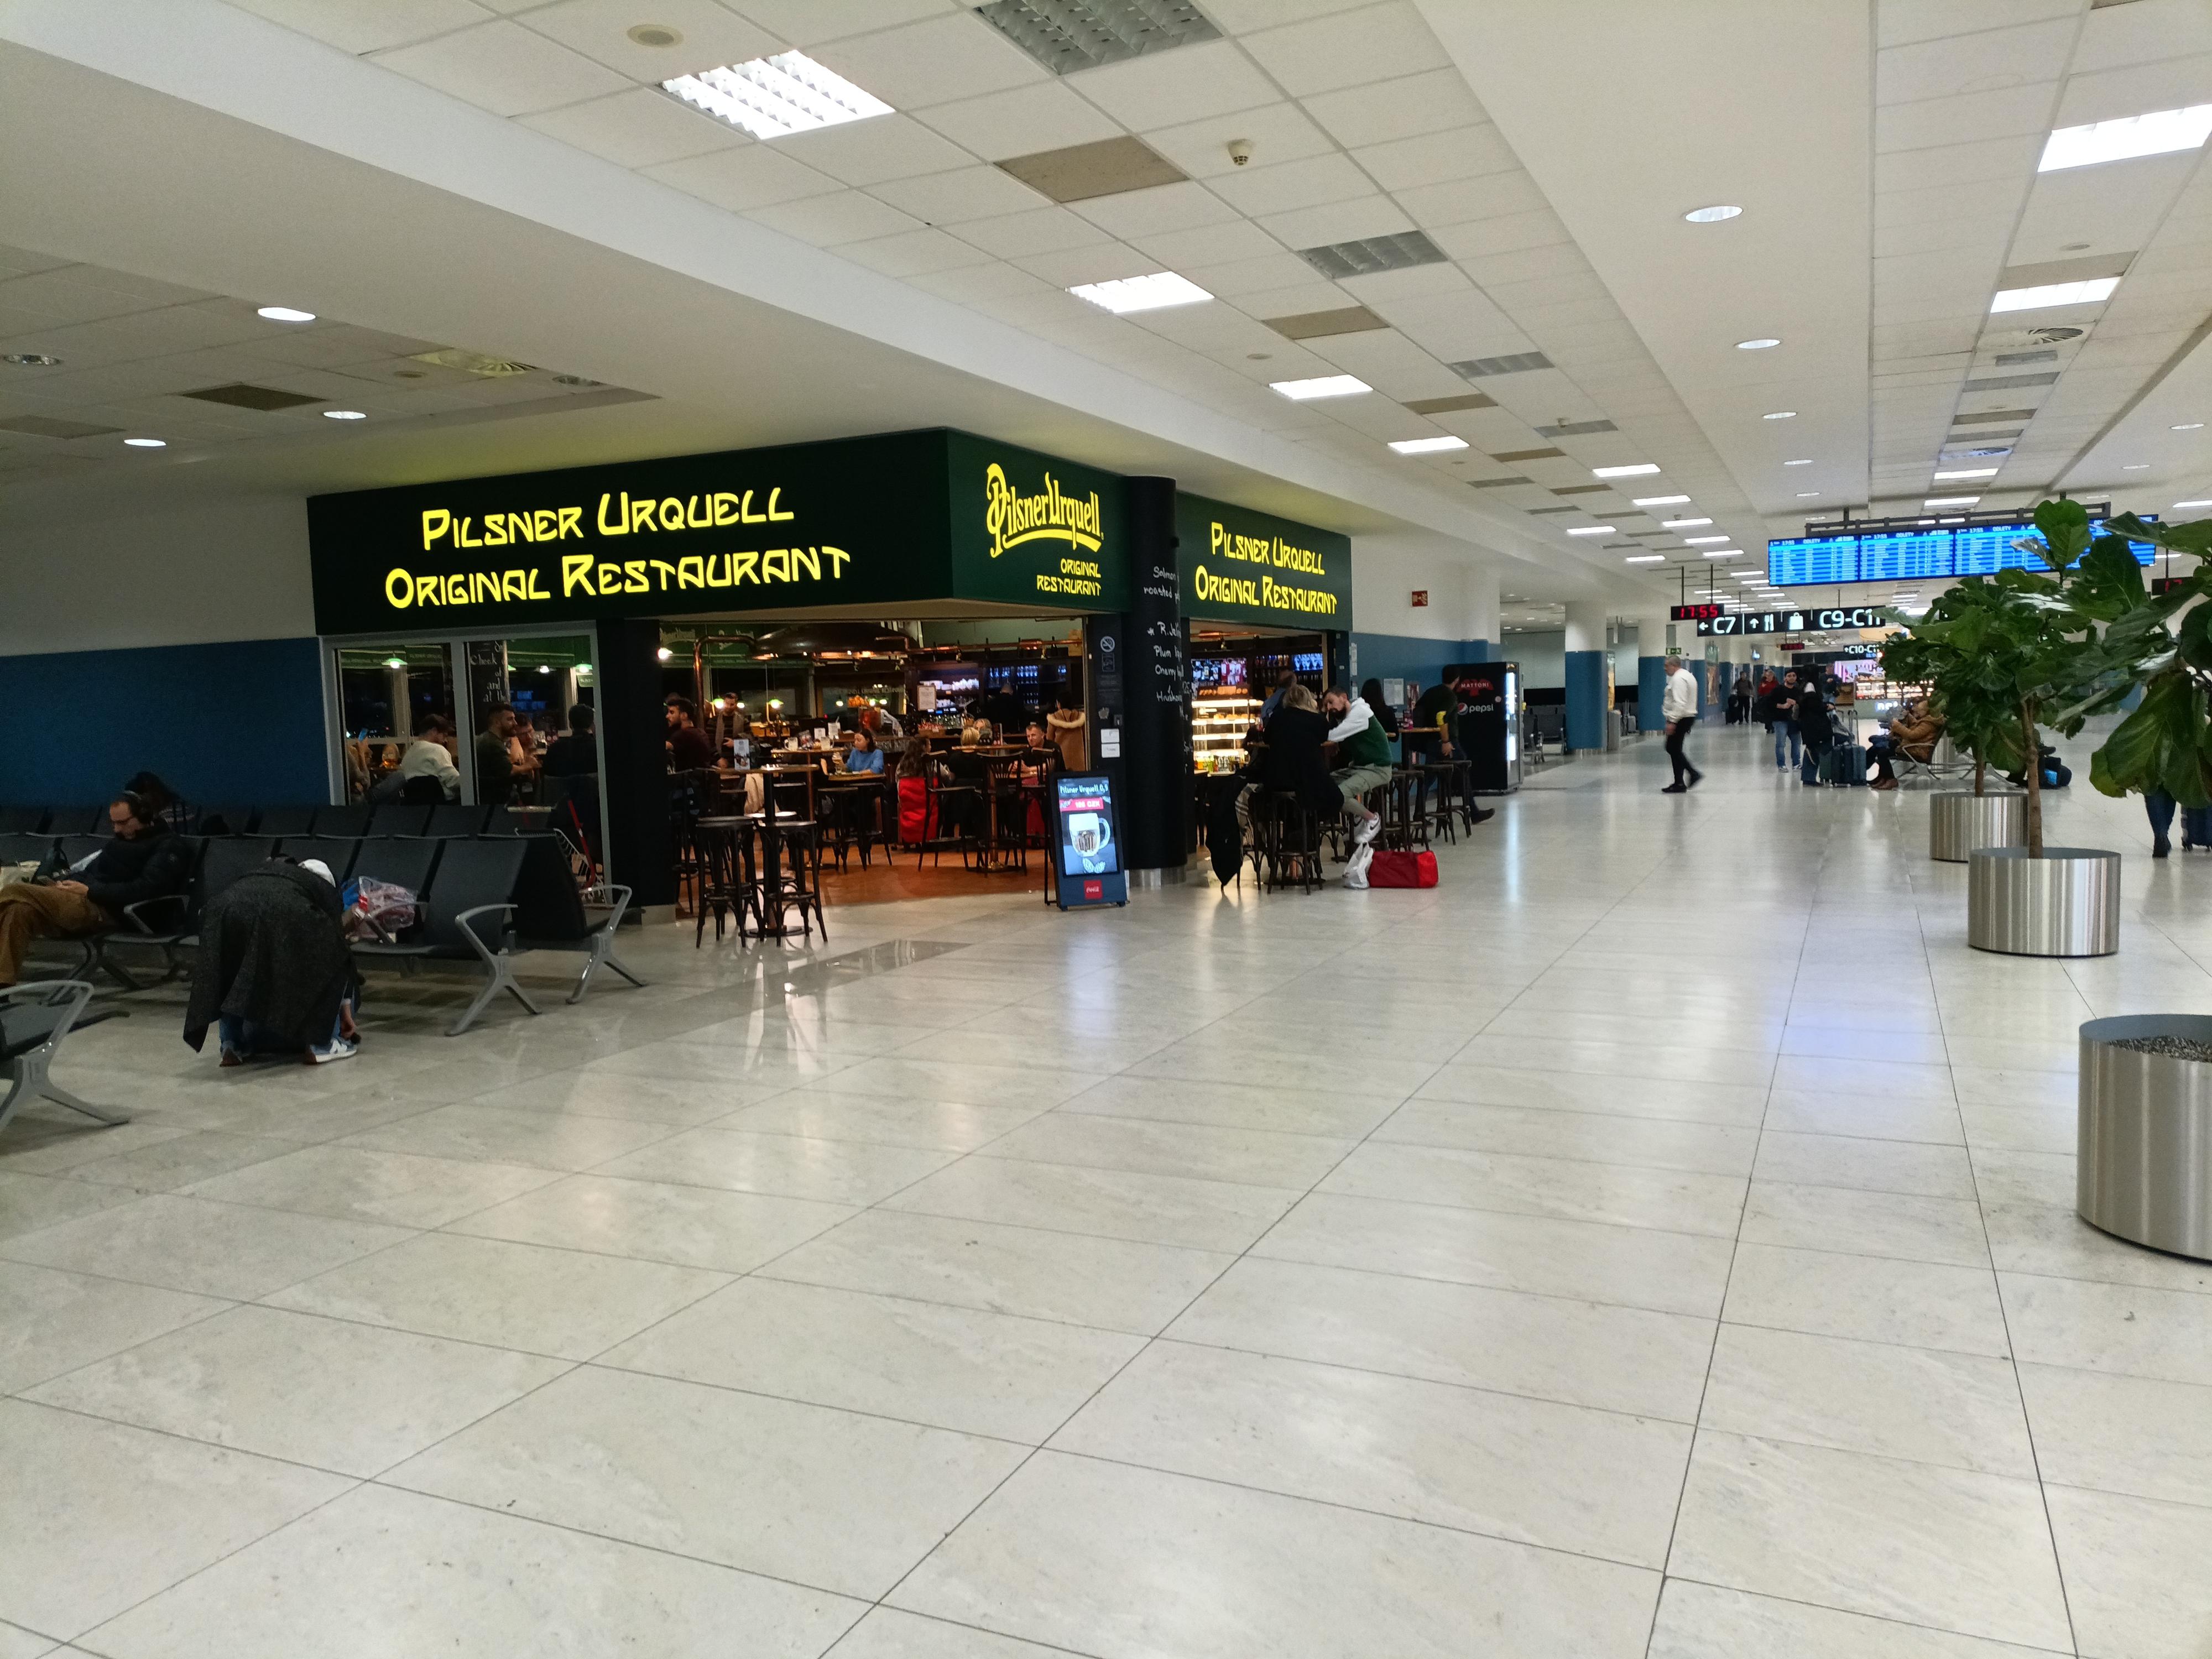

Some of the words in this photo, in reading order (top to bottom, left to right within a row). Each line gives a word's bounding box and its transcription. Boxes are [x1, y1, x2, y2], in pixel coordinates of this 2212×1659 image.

[987, 463, 1050, 557] Pilsner
[1045, 472, 1102, 550] Urquell
[1060, 558, 1102, 578] ORIGINAL
[1037, 575, 1102, 596] RESTAURANT
[1680, 604, 1719, 619] 17:55
[1713, 616, 1736, 634] C7
[1469, 703, 1494, 713] pepsi
[1060, 785, 1078, 794] Pilsner
